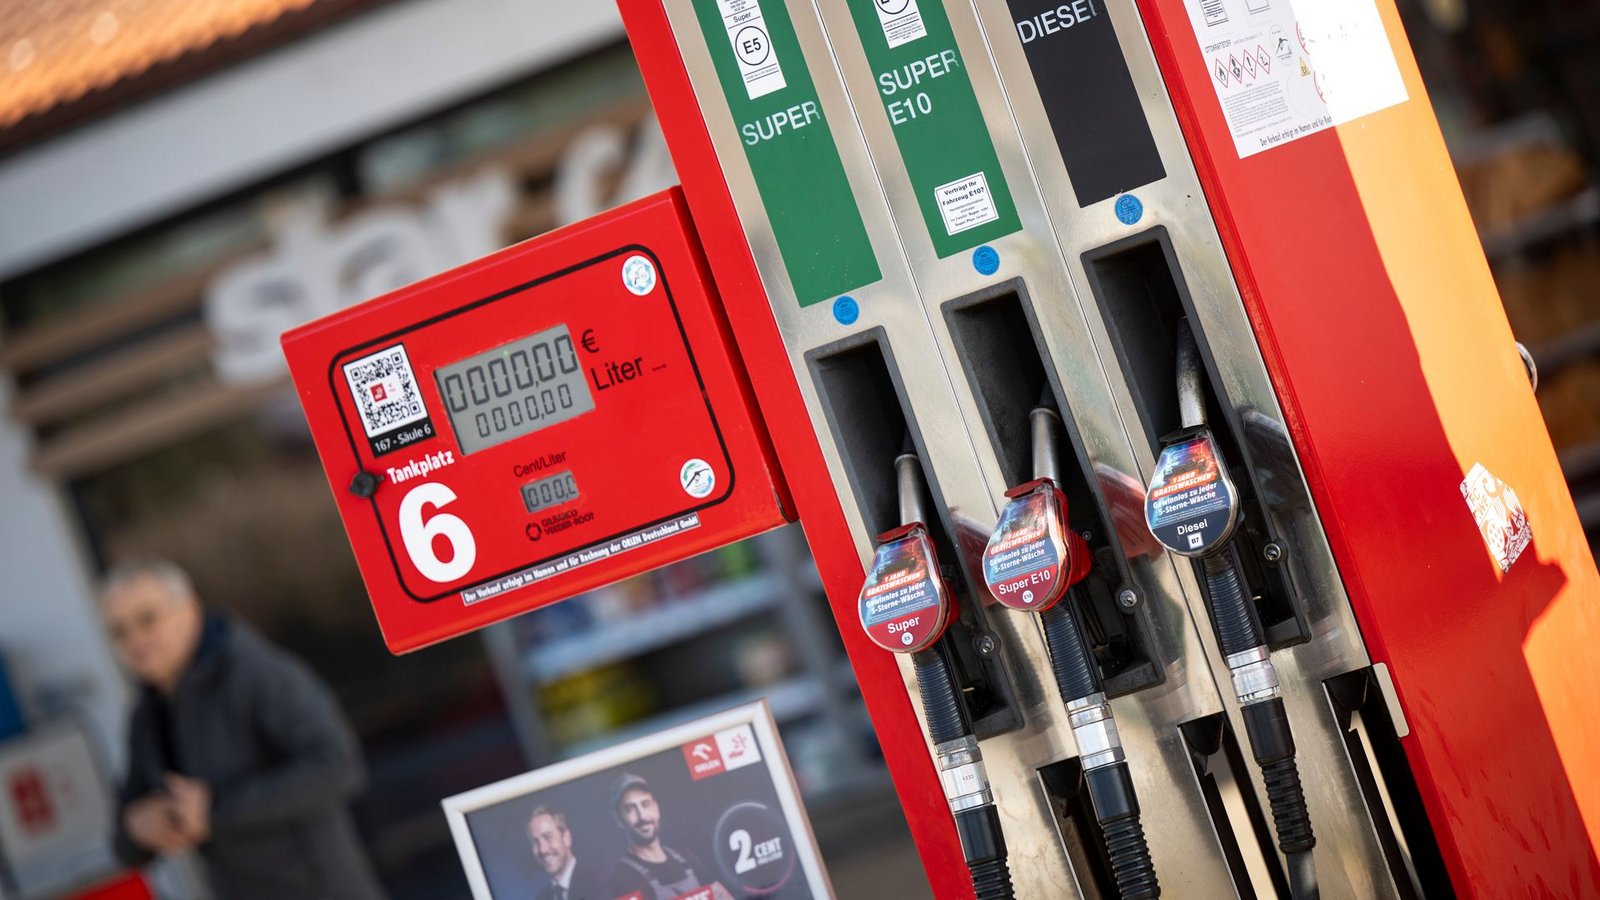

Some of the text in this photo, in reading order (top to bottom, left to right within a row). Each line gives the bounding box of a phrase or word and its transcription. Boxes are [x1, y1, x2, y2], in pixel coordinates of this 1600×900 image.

[733, 12, 751, 23] Super
[743, 37, 762, 54] E5
[879, 49, 960, 96] SUPER
[888, 92, 932, 126] E10
[742, 100, 821, 146] SUPER
[942, 194, 969, 206] Fahrzeug
[969, 187, 984, 196] E10?
[944, 183, 967, 195] Verträgt
[581, 328, 600, 354] €
[590, 356, 644, 391] Liter
[475, 383, 574, 438] 0000,00
[375, 439, 391, 453] 167
[397, 427, 424, 445] Säule
[424, 424, 431, 435] 6
[387, 451, 455, 484] Tankplatz
[513, 452, 567, 478] Cent/Liter
[1152, 481, 1218, 510] Gewinnlos zu jeder
[1158, 490, 1217, 516] 5-Sterne-Wäsche
[398, 481, 477, 583] 6
[1176, 518, 1208, 536] Diesel
[989, 539, 1046, 567] Gewinnlos zu jeder
[1191, 537, 1200, 545] B7
[464, 515, 699, 603] Der Verkauf erfolgt im Namen und für Rechnung der ORLEN Deutschland GmbH
[994, 548, 1046, 574] 5-Sterne-Wäsche
[865, 581, 926, 608] Gewinnlos zu jeder
[998, 569, 1051, 595] Super E10
[871, 590, 925, 615] 5-Sterne-Wäsche
[887, 616, 920, 634] Super
[728, 829, 757, 875] 2
[753, 836, 783, 859] CENT
